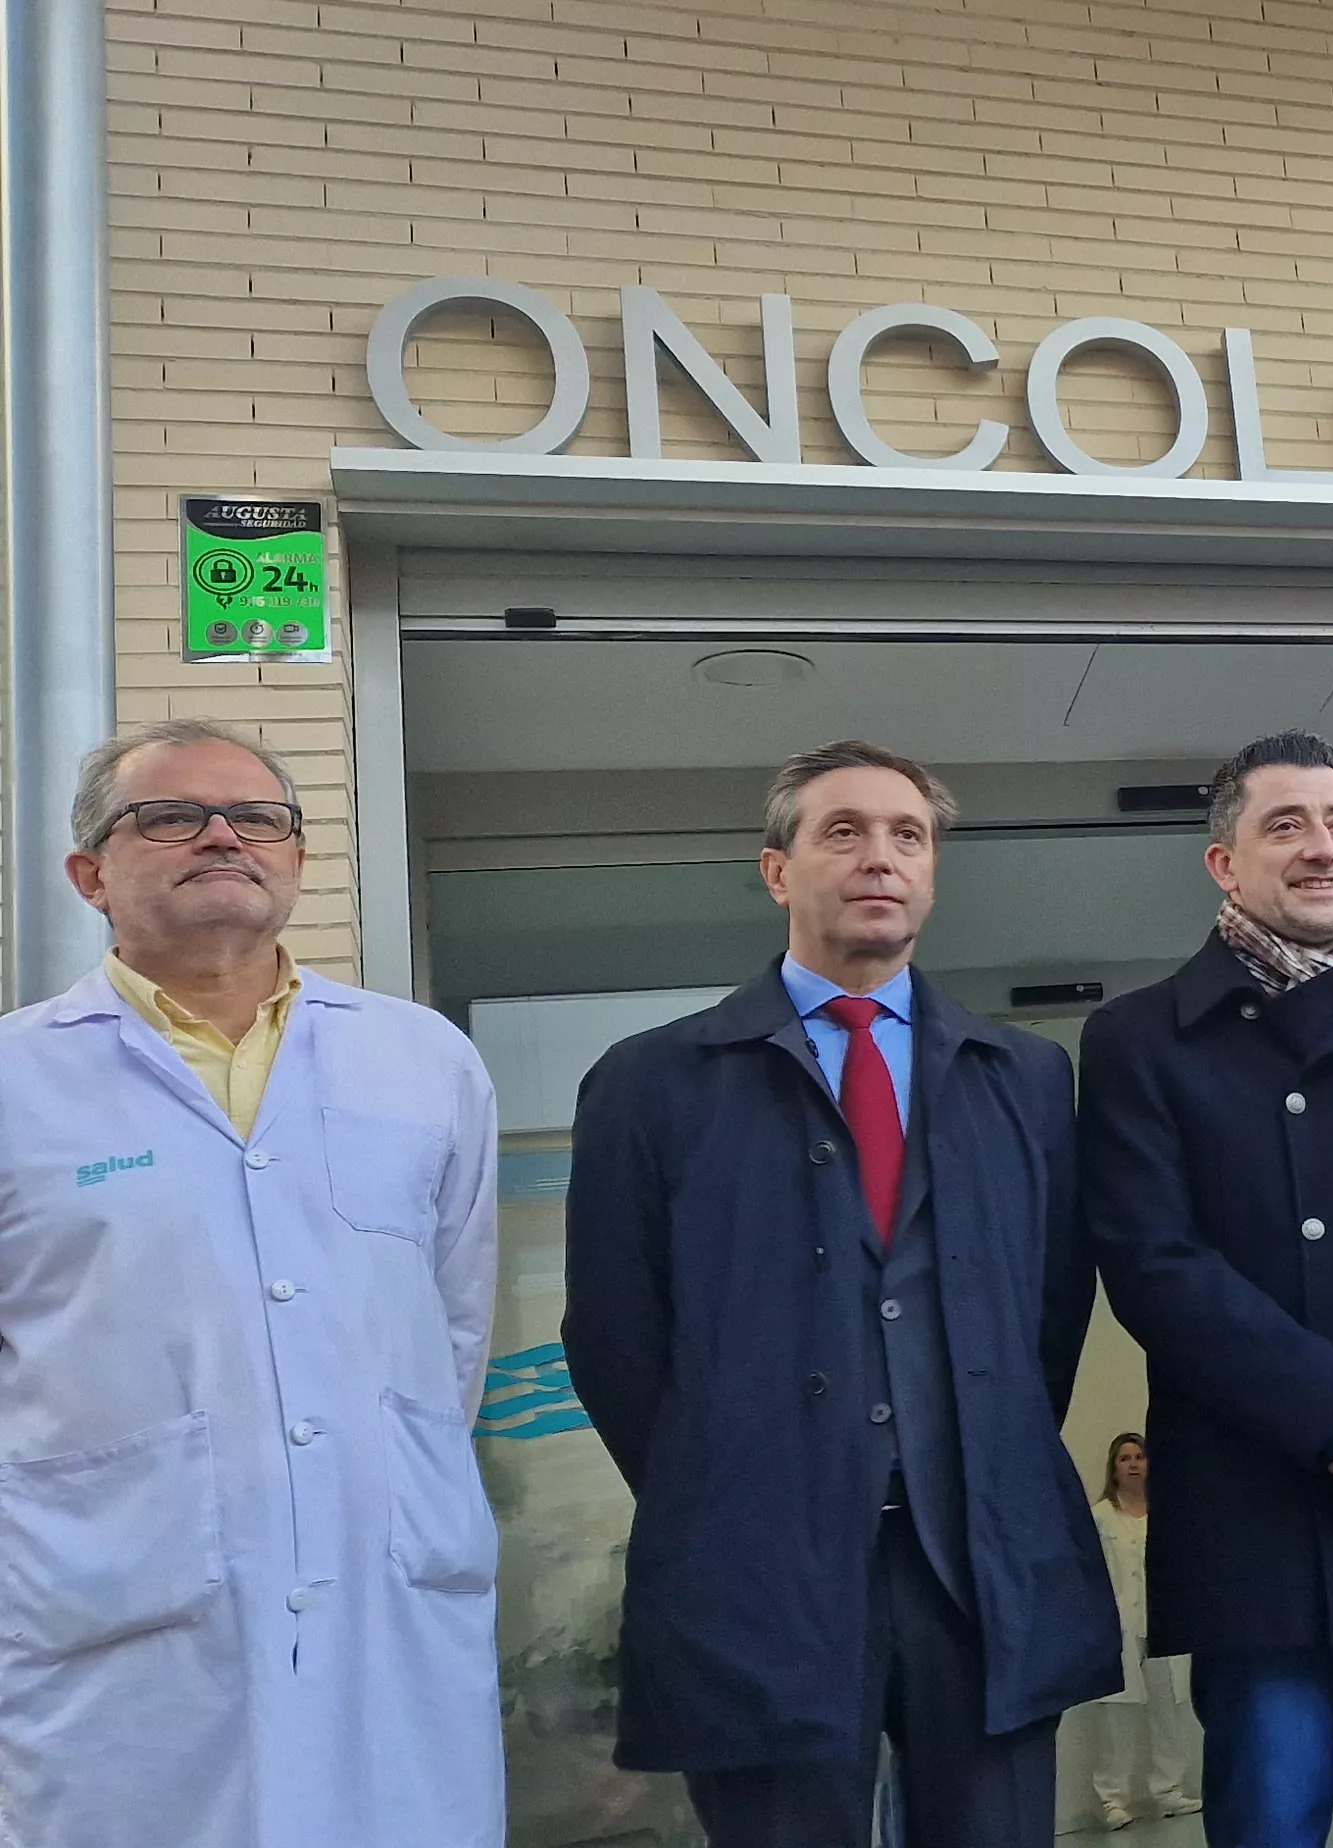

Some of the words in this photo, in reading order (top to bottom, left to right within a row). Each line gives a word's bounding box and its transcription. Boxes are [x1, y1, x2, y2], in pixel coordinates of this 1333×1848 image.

[203, 505, 307, 520] AUGUSTA
[240, 519, 307, 528] SEGURIDAD
[262, 565, 319, 592] 24h
[76, 1149, 153, 1180] salud
